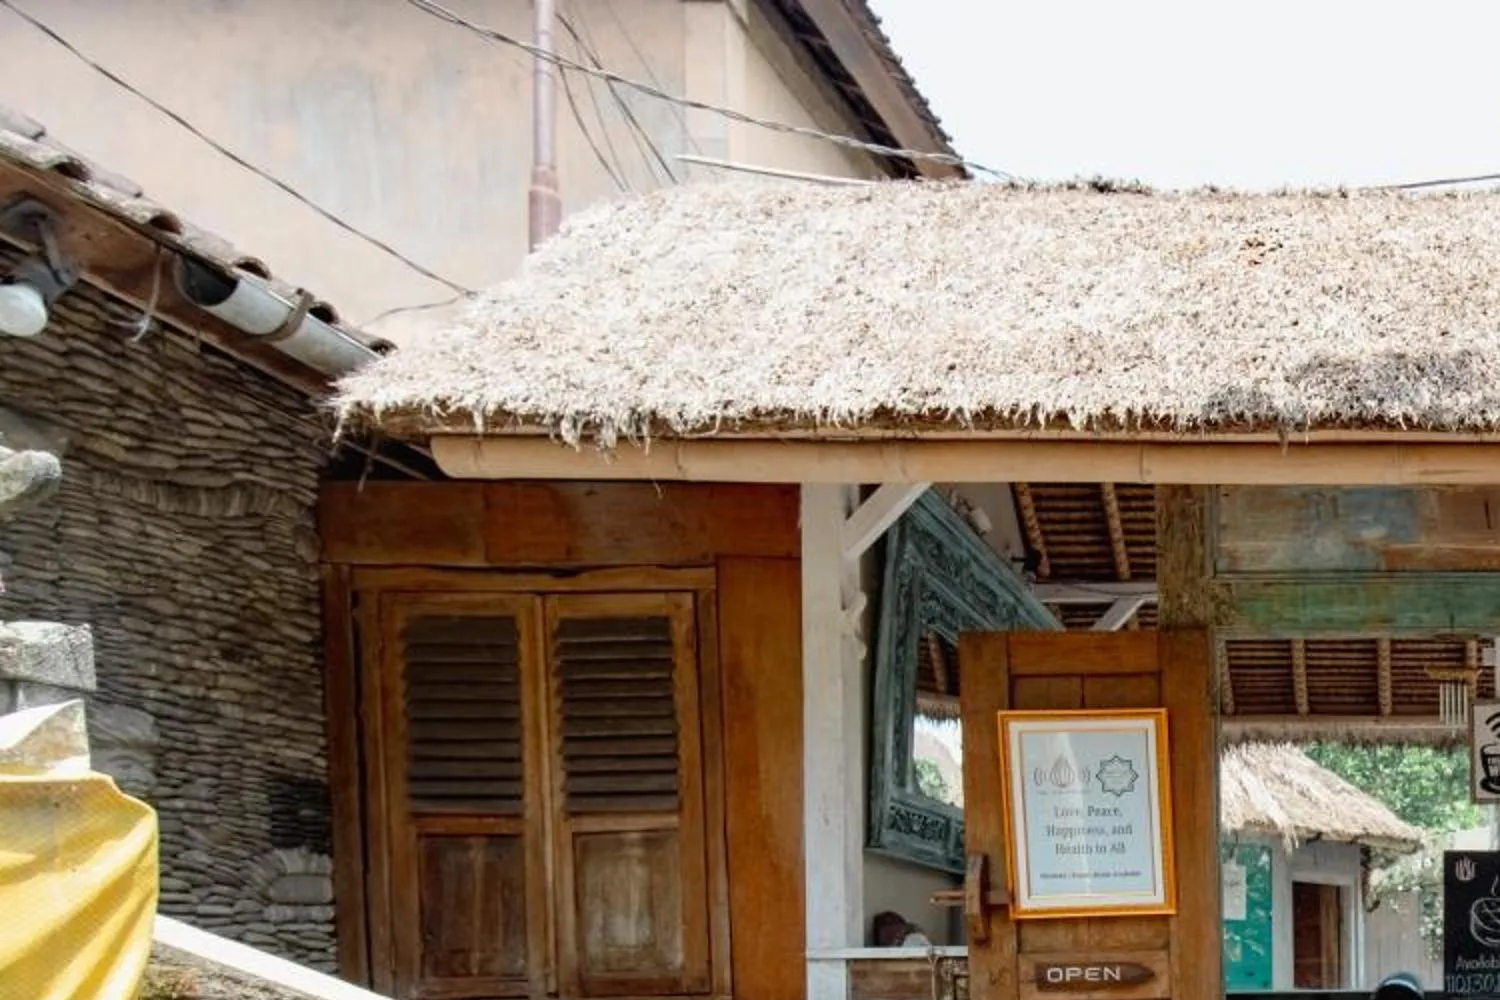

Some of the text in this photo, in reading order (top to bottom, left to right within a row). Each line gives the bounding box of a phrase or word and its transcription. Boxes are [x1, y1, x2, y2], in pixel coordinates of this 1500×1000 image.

[1087, 804, 1123, 818] Peace,
[1111, 822, 1133, 836] and
[1047, 965, 1121, 983] OPEN
